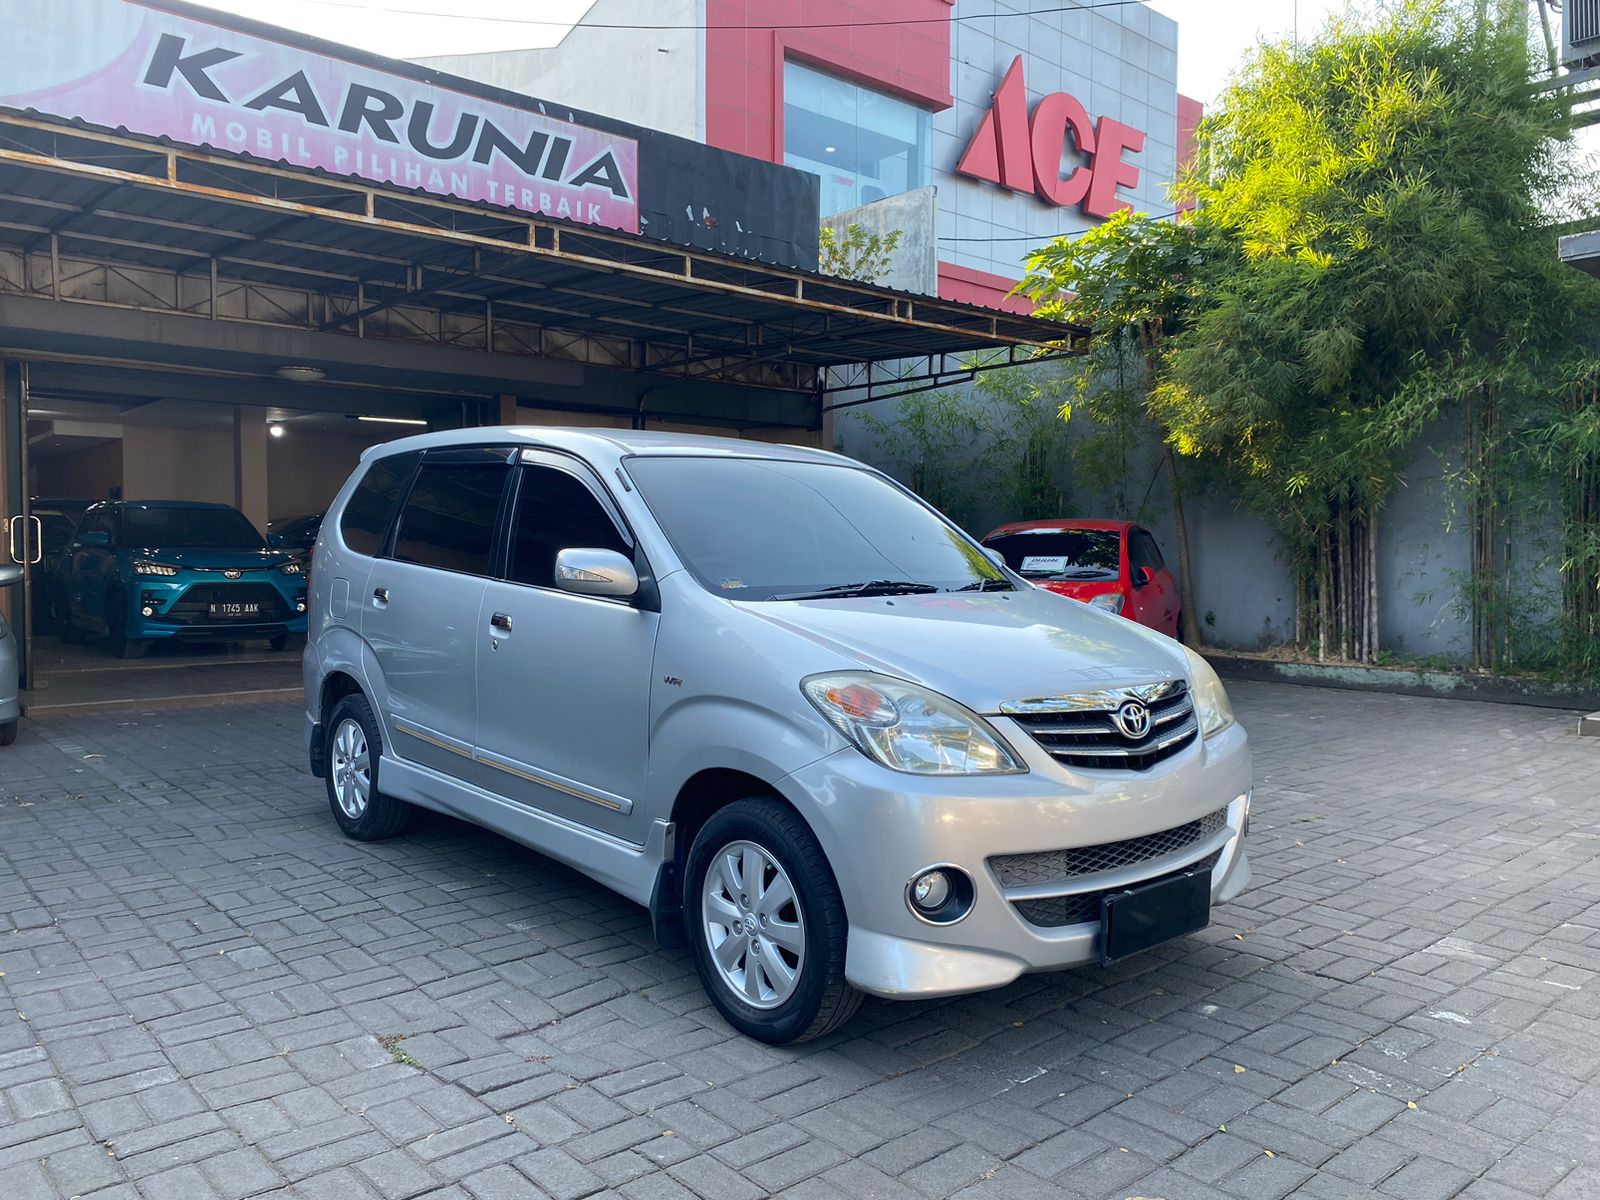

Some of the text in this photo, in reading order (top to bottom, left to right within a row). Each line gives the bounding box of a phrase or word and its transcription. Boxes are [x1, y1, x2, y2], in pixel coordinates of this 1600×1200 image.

[143, 32, 630, 199] KARUNIA
[191, 113, 601, 222] MOBIL PILIHAN TERBAIK
[956, 54, 1147, 221] ACE
[210, 603, 216, 613] N
[222, 603, 241, 613] 1745
